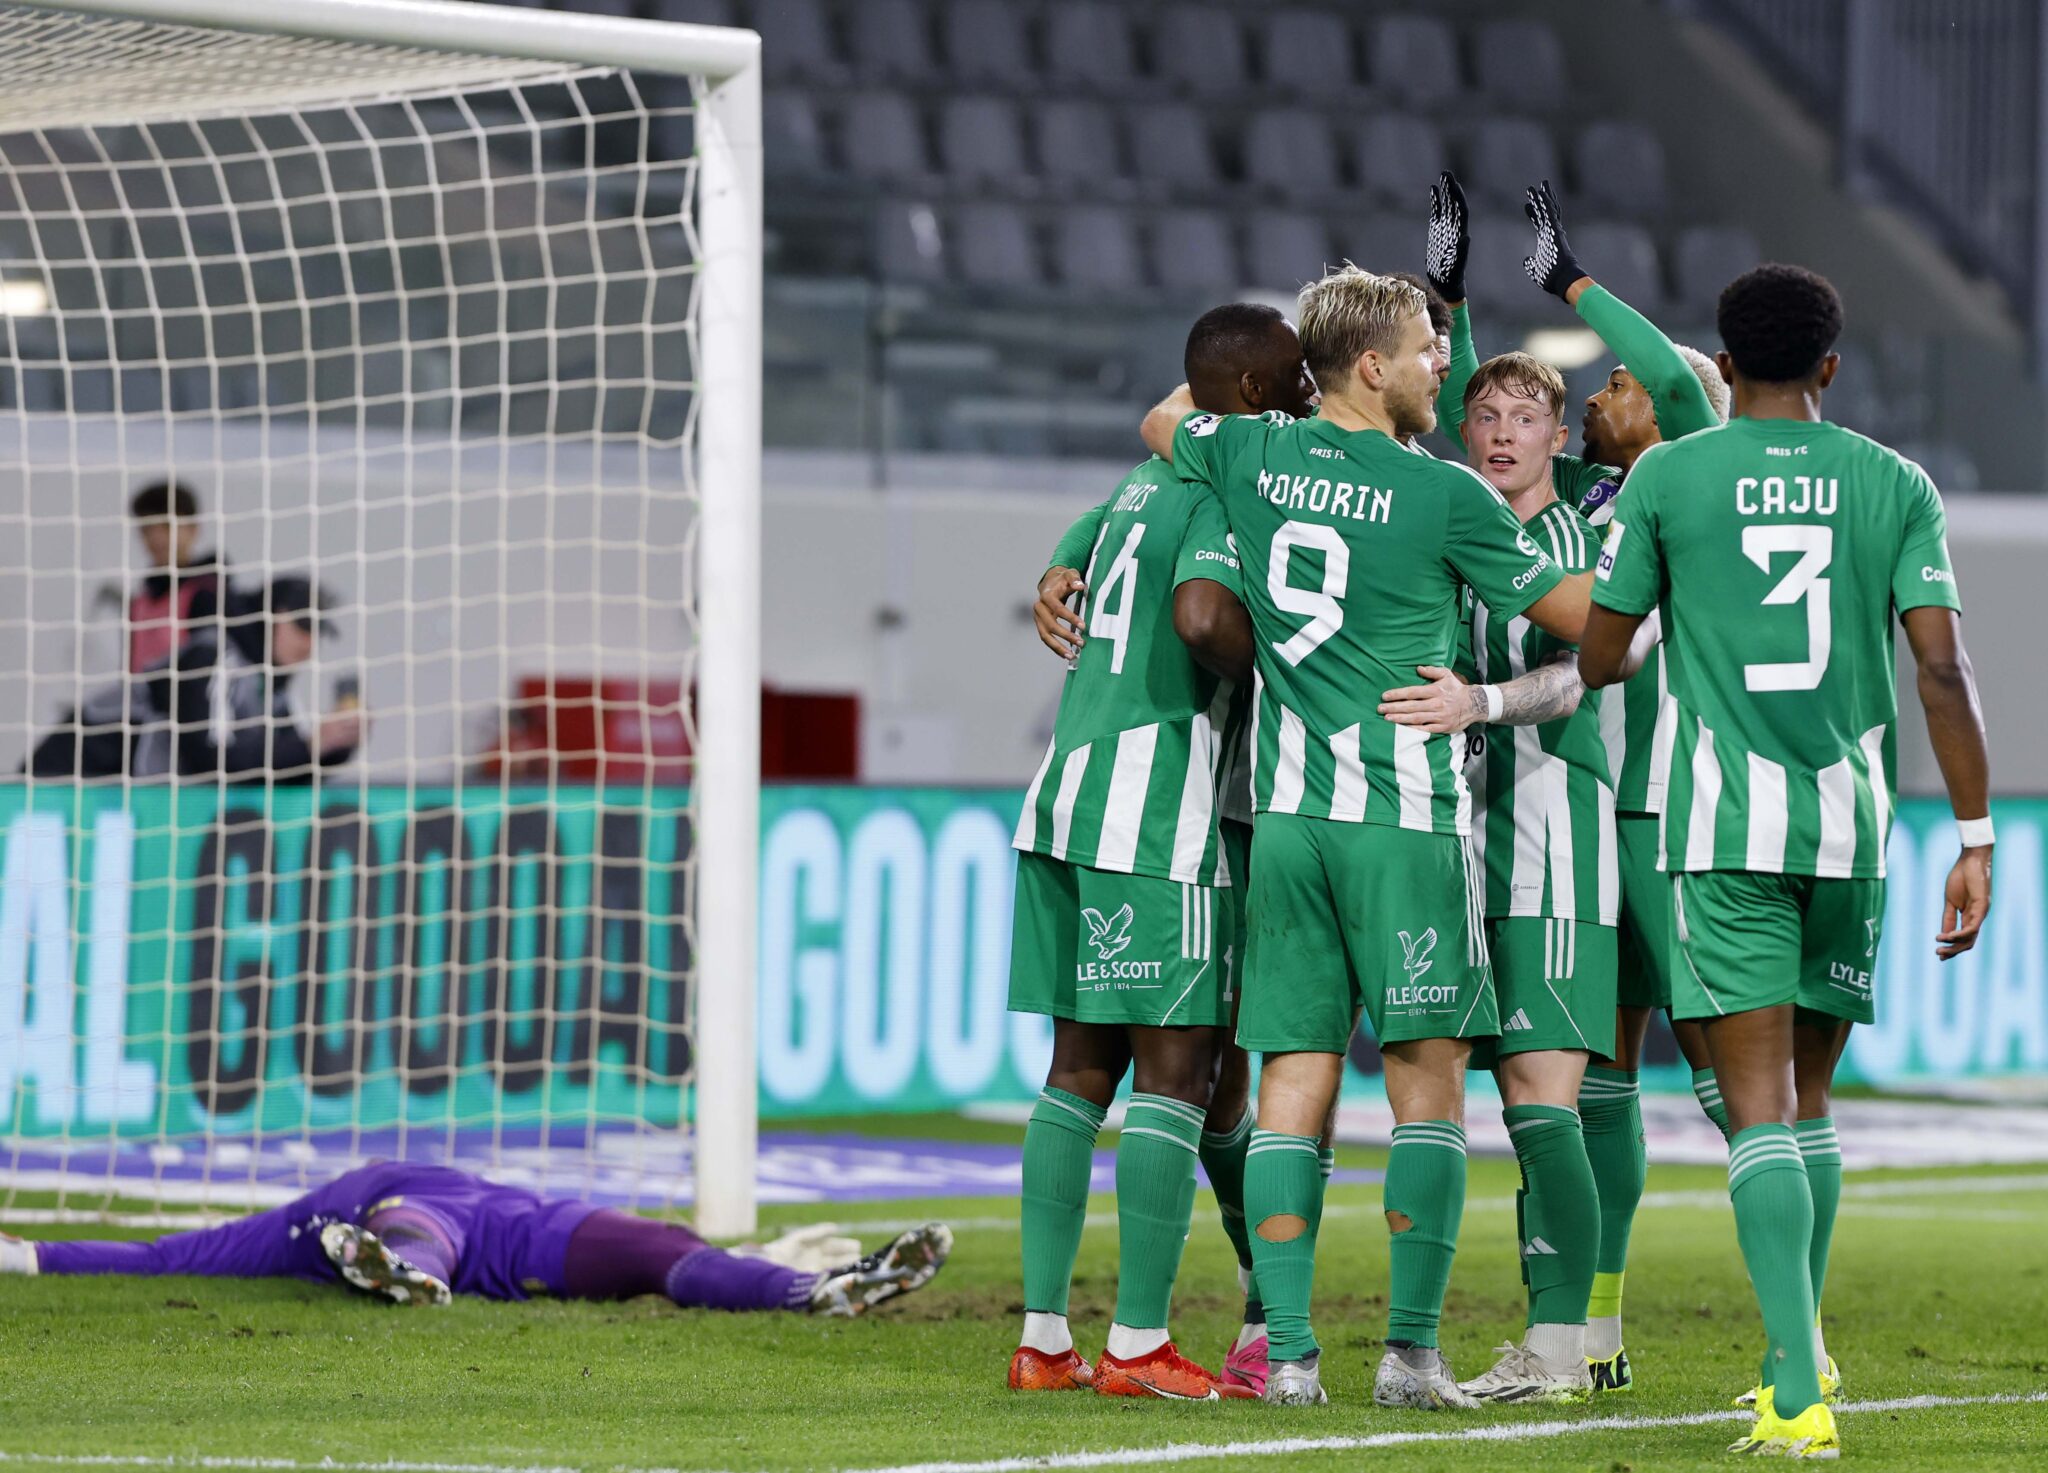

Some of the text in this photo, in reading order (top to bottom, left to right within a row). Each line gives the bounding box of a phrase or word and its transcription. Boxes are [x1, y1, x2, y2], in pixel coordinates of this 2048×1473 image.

[1308, 446, 1332, 459] ARIS
[1766, 445, 1809, 457] ARIS FC
[1736, 476, 1838, 516] CAJU
[1195, 549, 1241, 570] Coins
[1267, 519, 1350, 668] 9
[1741, 524, 1834, 692] 3
[759, 806, 1054, 1102] GOO
[1112, 961, 1162, 979] SCOTT
[1830, 961, 1869, 990] LYLE
[1094, 982, 1130, 992] EST 1874
[1385, 987, 1411, 1006] YLE
